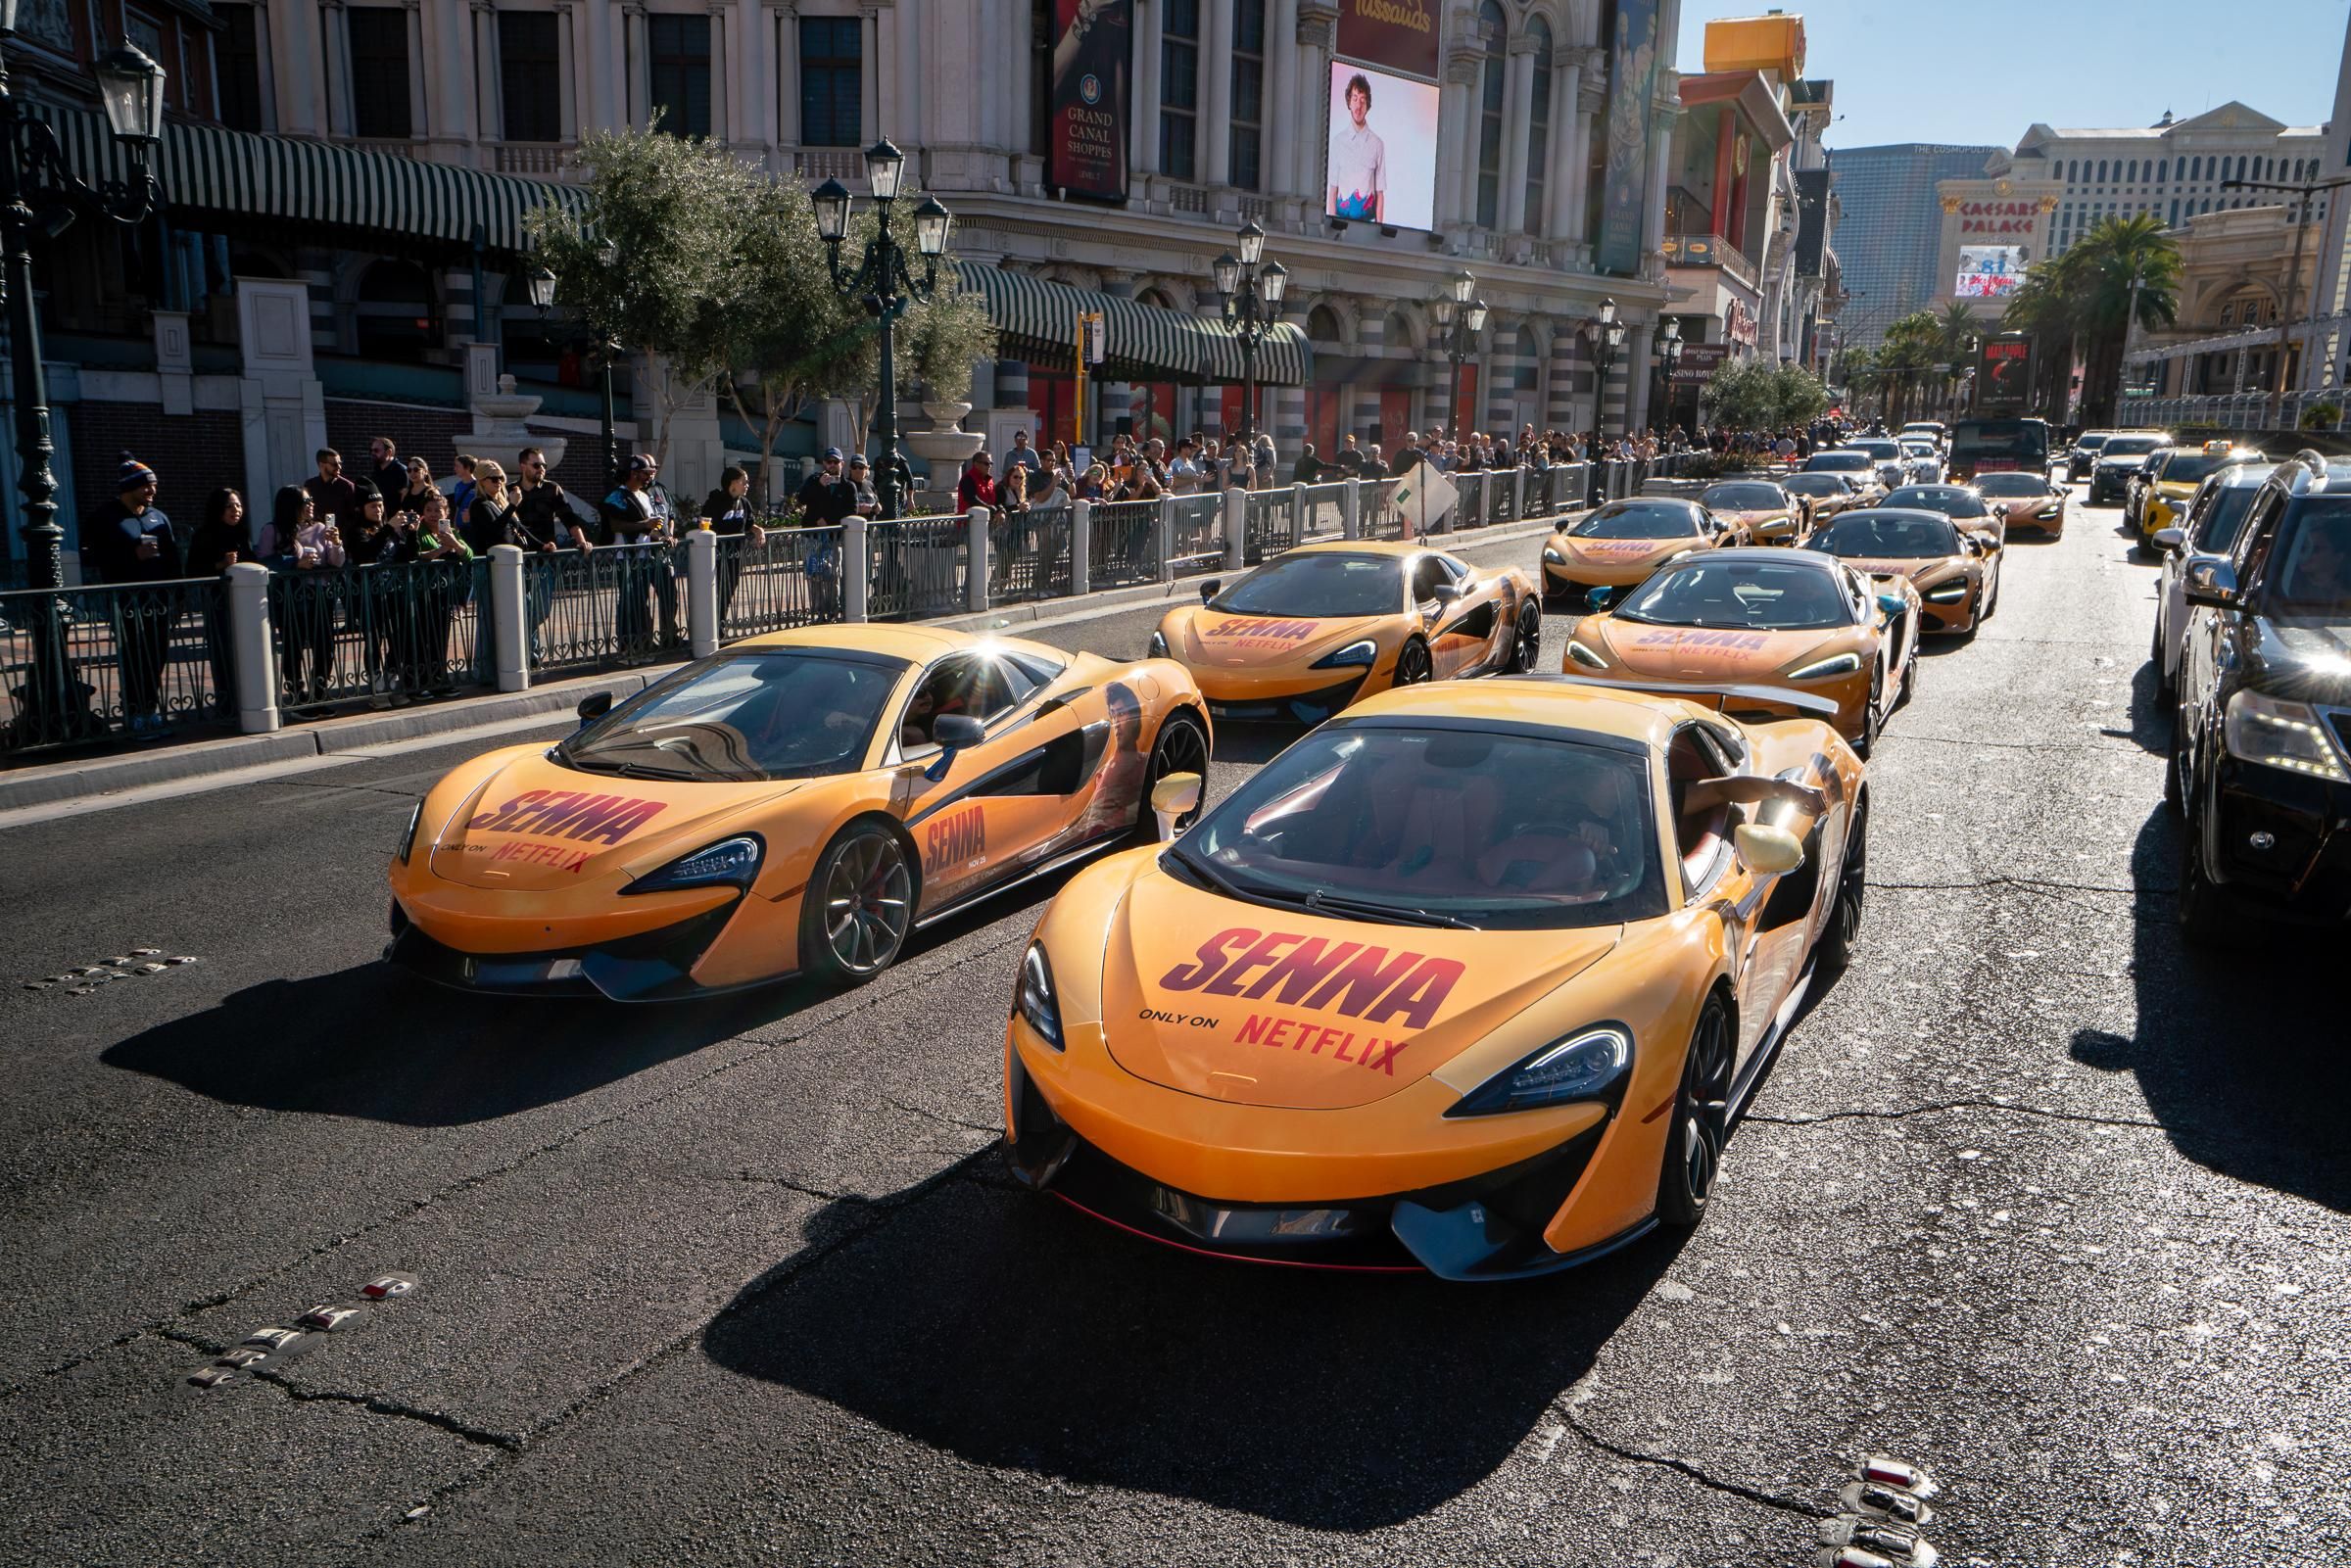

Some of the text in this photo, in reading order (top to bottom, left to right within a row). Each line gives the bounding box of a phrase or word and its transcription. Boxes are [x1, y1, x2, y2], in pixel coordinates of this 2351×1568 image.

[1068, 107, 1113, 126] GRAND
[1069, 124, 1111, 143] CANAL
[1067, 140, 1113, 158] SHOPPES
[1914, 145, 1931, 154] THE
[1960, 202, 2039, 216] CAESARS
[1961, 219, 2034, 233] PALACE
[1673, 369, 1694, 378] ASINO
[1584, 541, 1655, 553] SENNA
[1205, 618, 1320, 641] SENNA
[1233, 639, 1298, 651] NETFLIX
[1636, 630, 1769, 651] SENNA
[1678, 646, 1751, 661] NETFLIX
[464, 788, 668, 846] SENNA
[441, 843, 488, 853] ONLY ON
[925, 805, 985, 877] SENNA
[490, 840, 596, 874] NETFLIX
[968, 858, 980, 870] NOV
[1159, 927, 1466, 1030] SENNA
[1138, 1008, 1220, 1029] ONLY ON
[1232, 1013, 1411, 1077] NETFLIX
